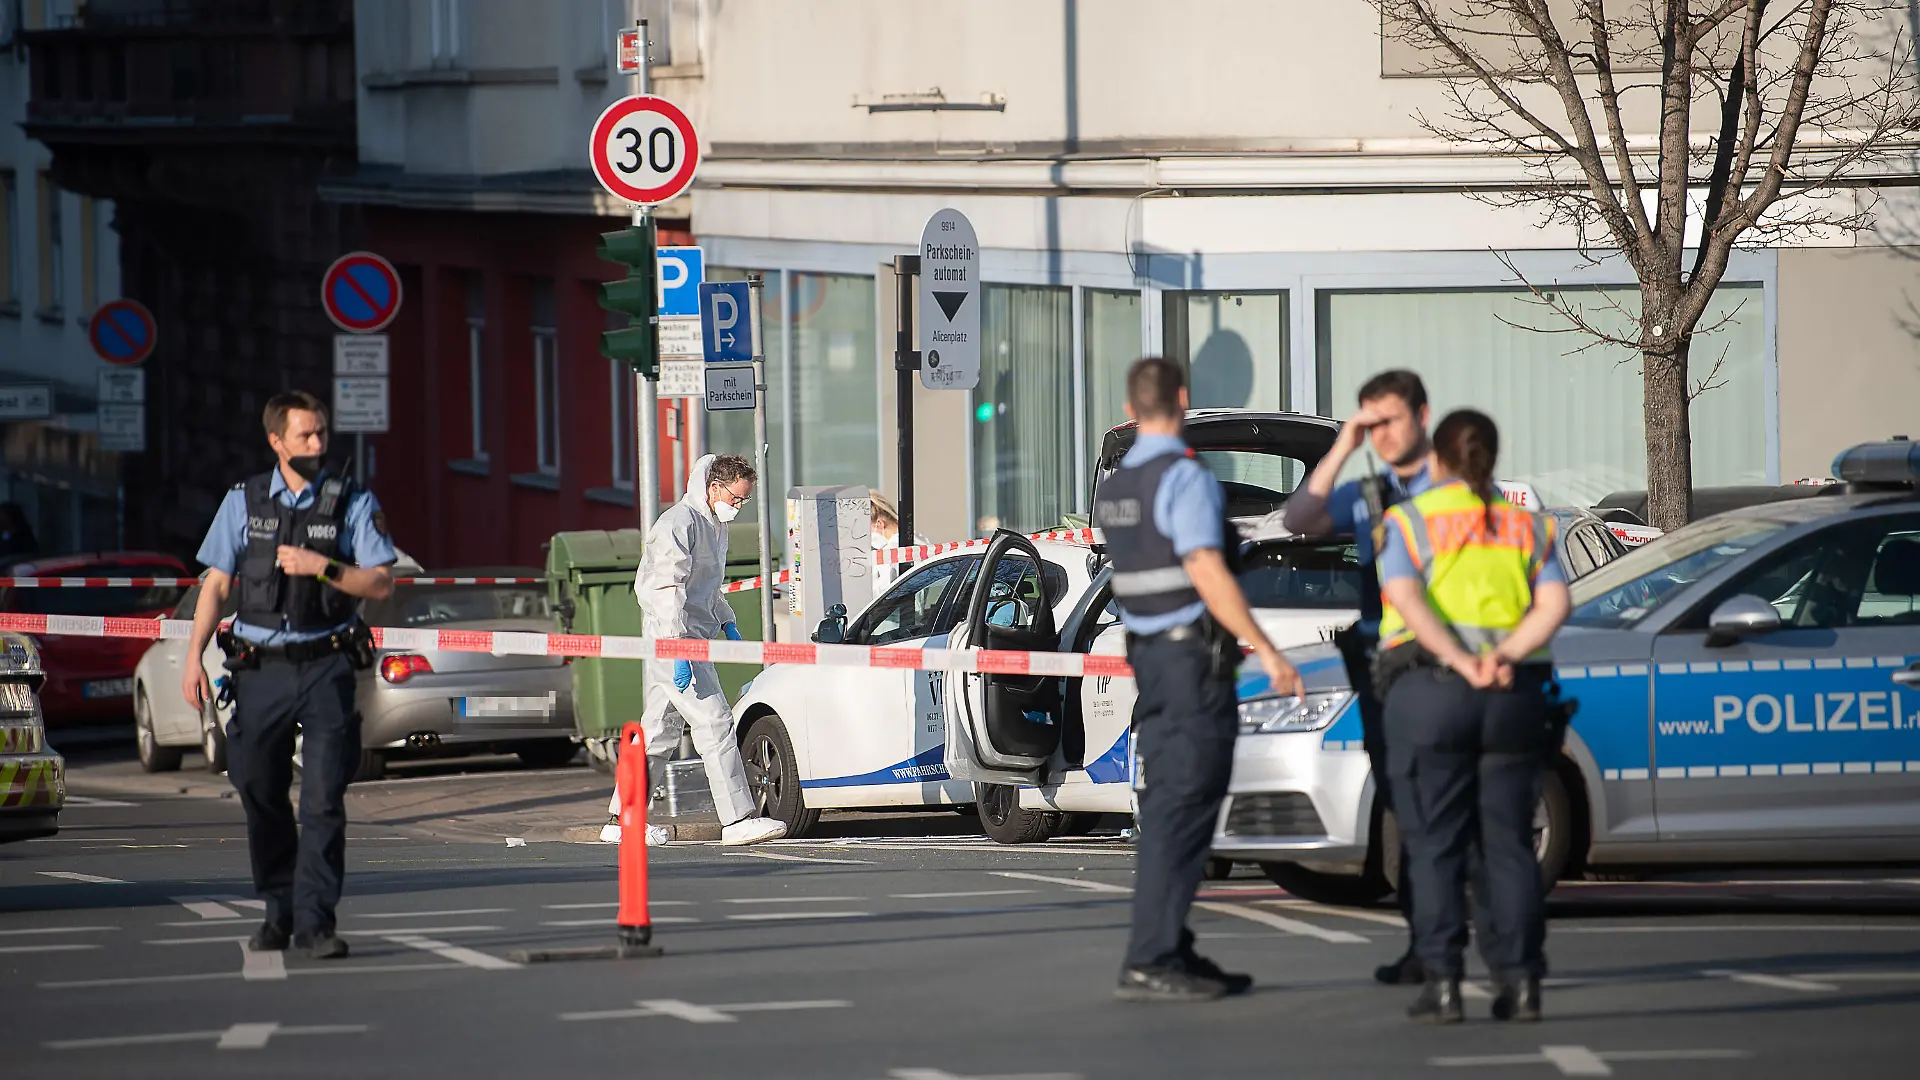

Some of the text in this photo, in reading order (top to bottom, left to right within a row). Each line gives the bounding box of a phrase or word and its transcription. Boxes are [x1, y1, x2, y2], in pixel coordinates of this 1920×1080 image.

[616, 127, 675, 173] 30
[941, 221, 955, 231] 9914
[926, 243, 974, 260] Parkschein-
[934, 266, 966, 281] automat
[657, 256, 689, 308] P
[712, 293, 738, 352] P
[932, 330, 967, 344] Alicenplatz
[723, 377, 737, 388] mit
[709, 390, 752, 402] Parkschein
[307, 524, 337, 539] VIDEO
